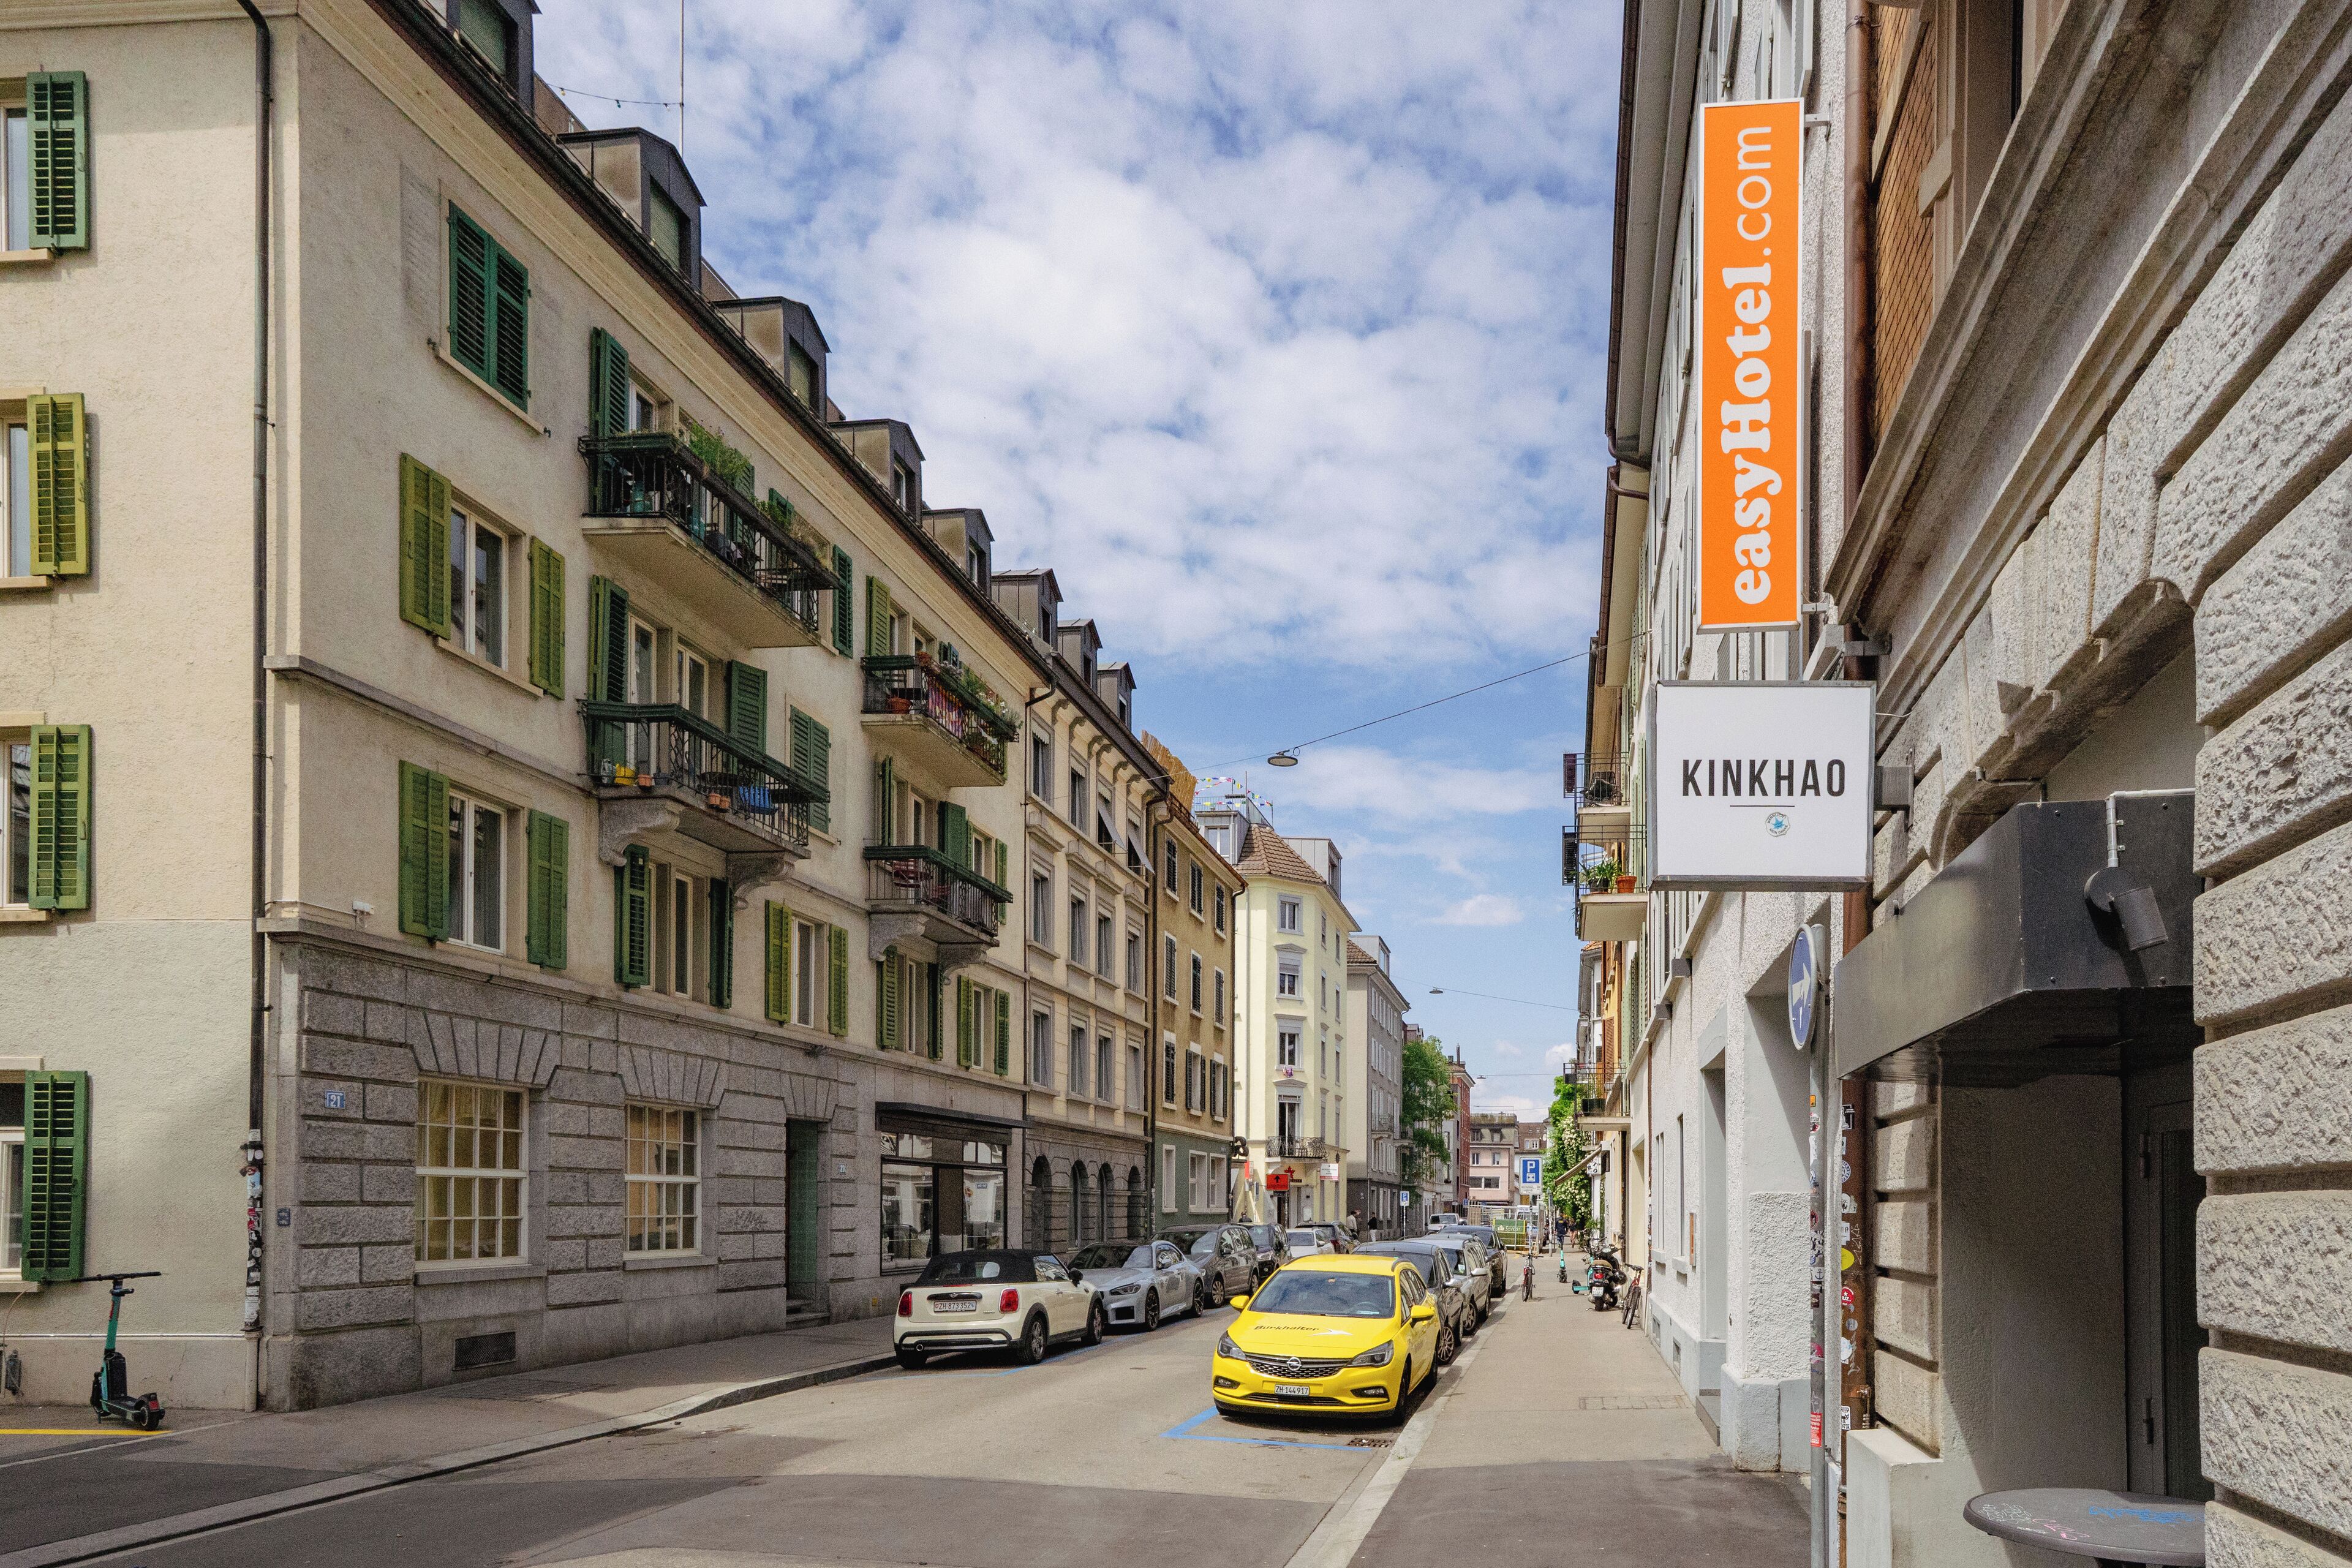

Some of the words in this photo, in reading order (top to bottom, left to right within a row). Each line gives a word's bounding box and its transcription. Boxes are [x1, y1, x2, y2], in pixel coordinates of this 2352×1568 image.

[1721, 126, 1782, 605] easyHotel.com
[1683, 759, 1845, 797] KINKHAO
[331, 1095, 341, 1107] 21
[1527, 1161, 1535, 1173] P
